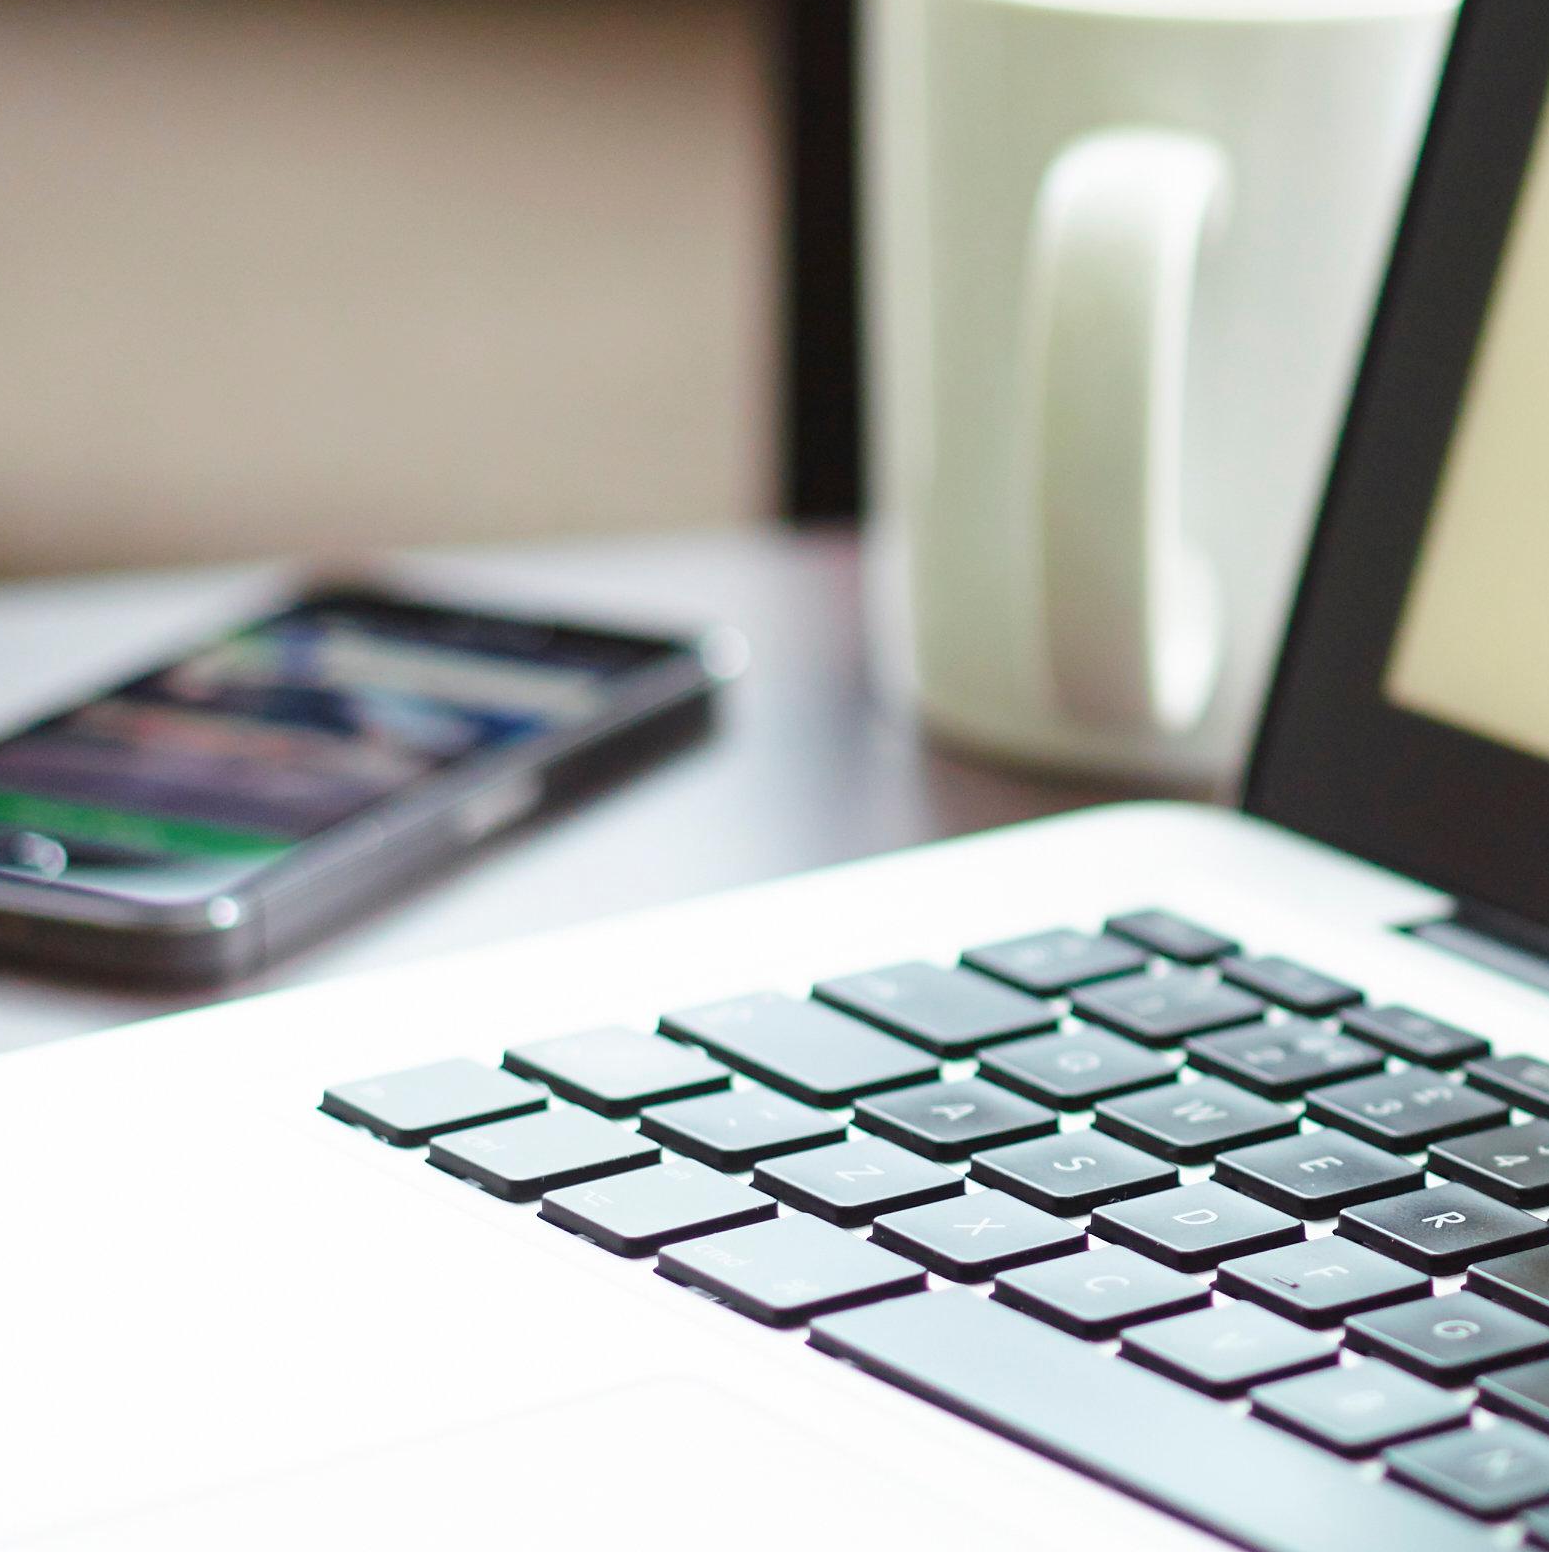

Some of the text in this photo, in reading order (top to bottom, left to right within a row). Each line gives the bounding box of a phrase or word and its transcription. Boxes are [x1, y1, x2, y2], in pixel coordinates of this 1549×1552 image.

[931, 1102, 976, 1121] A
[1172, 1098, 1229, 1125] W
[1364, 1098, 1402, 1118] 3
[1053, 1156, 1096, 1172] S
[1299, 1155, 1343, 1174] E
[1493, 1153, 1529, 1169] 4
[835, 1163, 886, 1183] Z
[953, 1217, 1006, 1236] X
[1172, 1209, 1219, 1225] D
[1421, 1210, 1467, 1230] R
[693, 1243, 752, 1268] cmd
[1303, 1264, 1349, 1282] F
[1085, 1275, 1130, 1292] C
[1432, 1318, 1481, 1341] G
